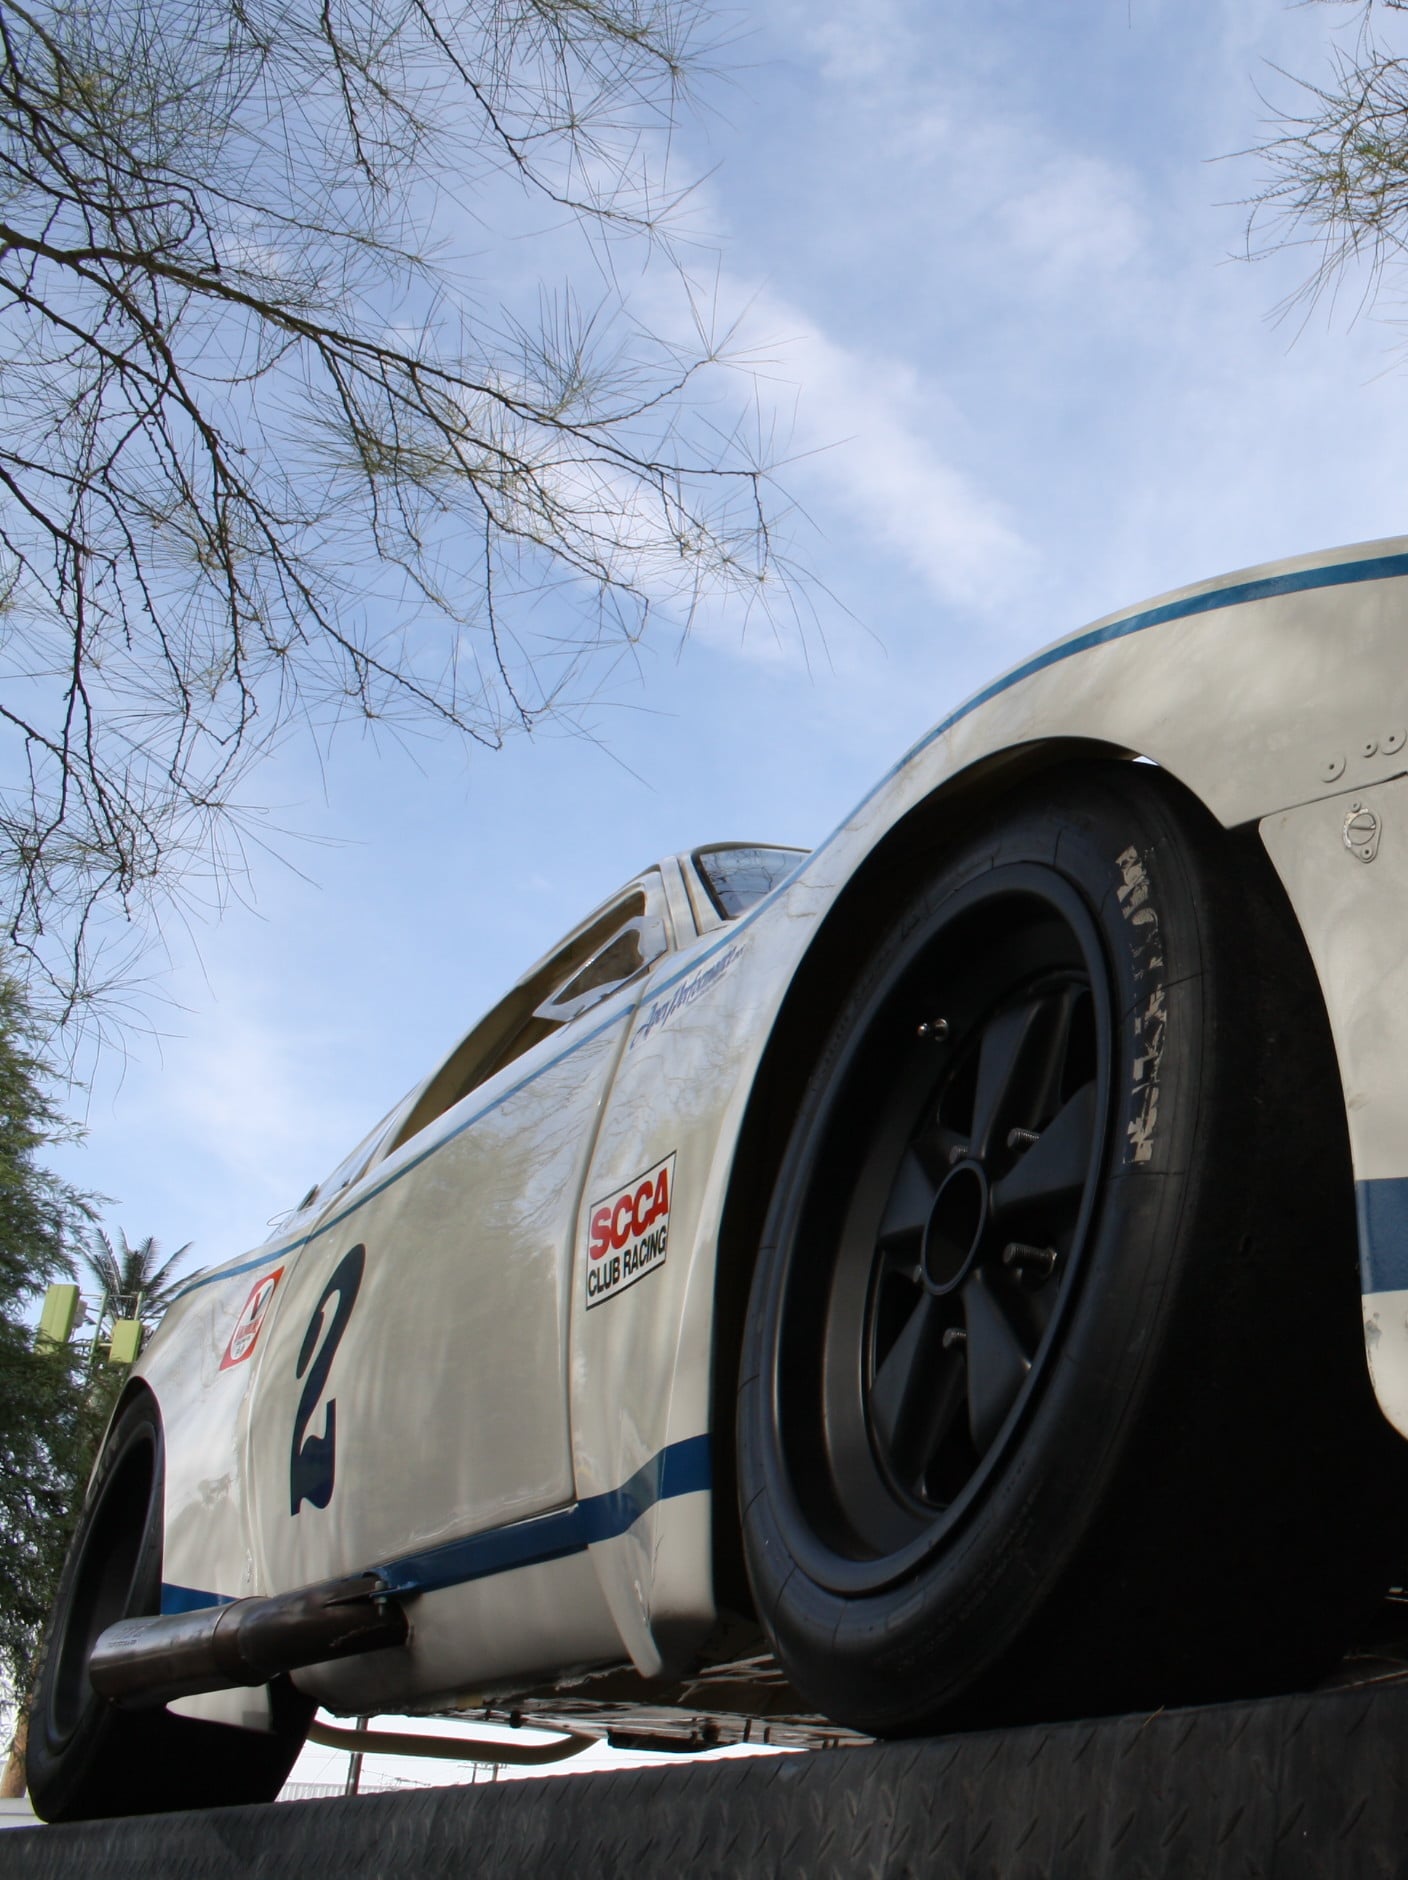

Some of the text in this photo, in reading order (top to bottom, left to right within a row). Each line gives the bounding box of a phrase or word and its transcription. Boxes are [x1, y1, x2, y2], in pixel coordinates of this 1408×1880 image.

[589, 1167, 669, 1261] SCCA
[588, 1225, 668, 1298] CLUB RACING
[290, 1243, 366, 1516] 2
